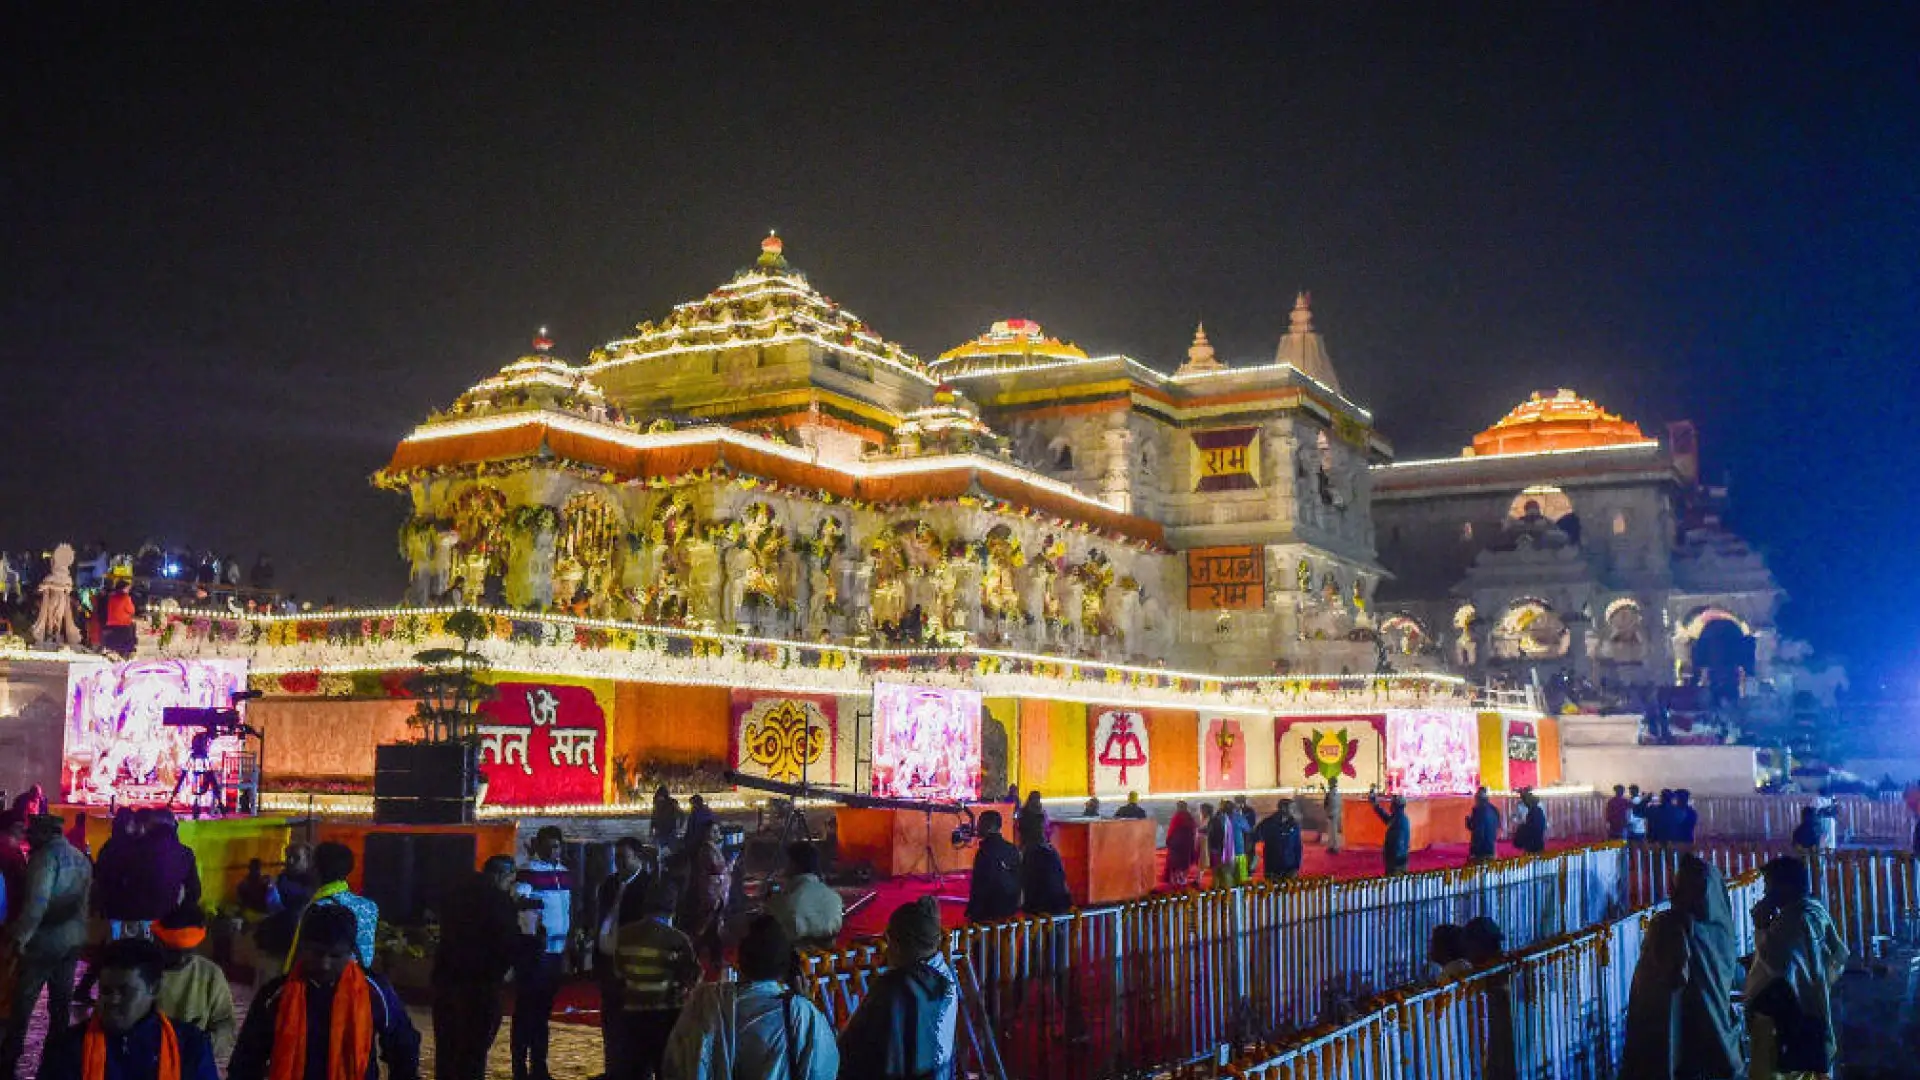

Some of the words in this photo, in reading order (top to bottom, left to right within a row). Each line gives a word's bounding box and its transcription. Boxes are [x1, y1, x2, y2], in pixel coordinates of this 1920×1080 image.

[1204, 446, 1246, 474] राम
[1204, 584, 1250, 607] राम
[549, 728, 598, 775] सत्
